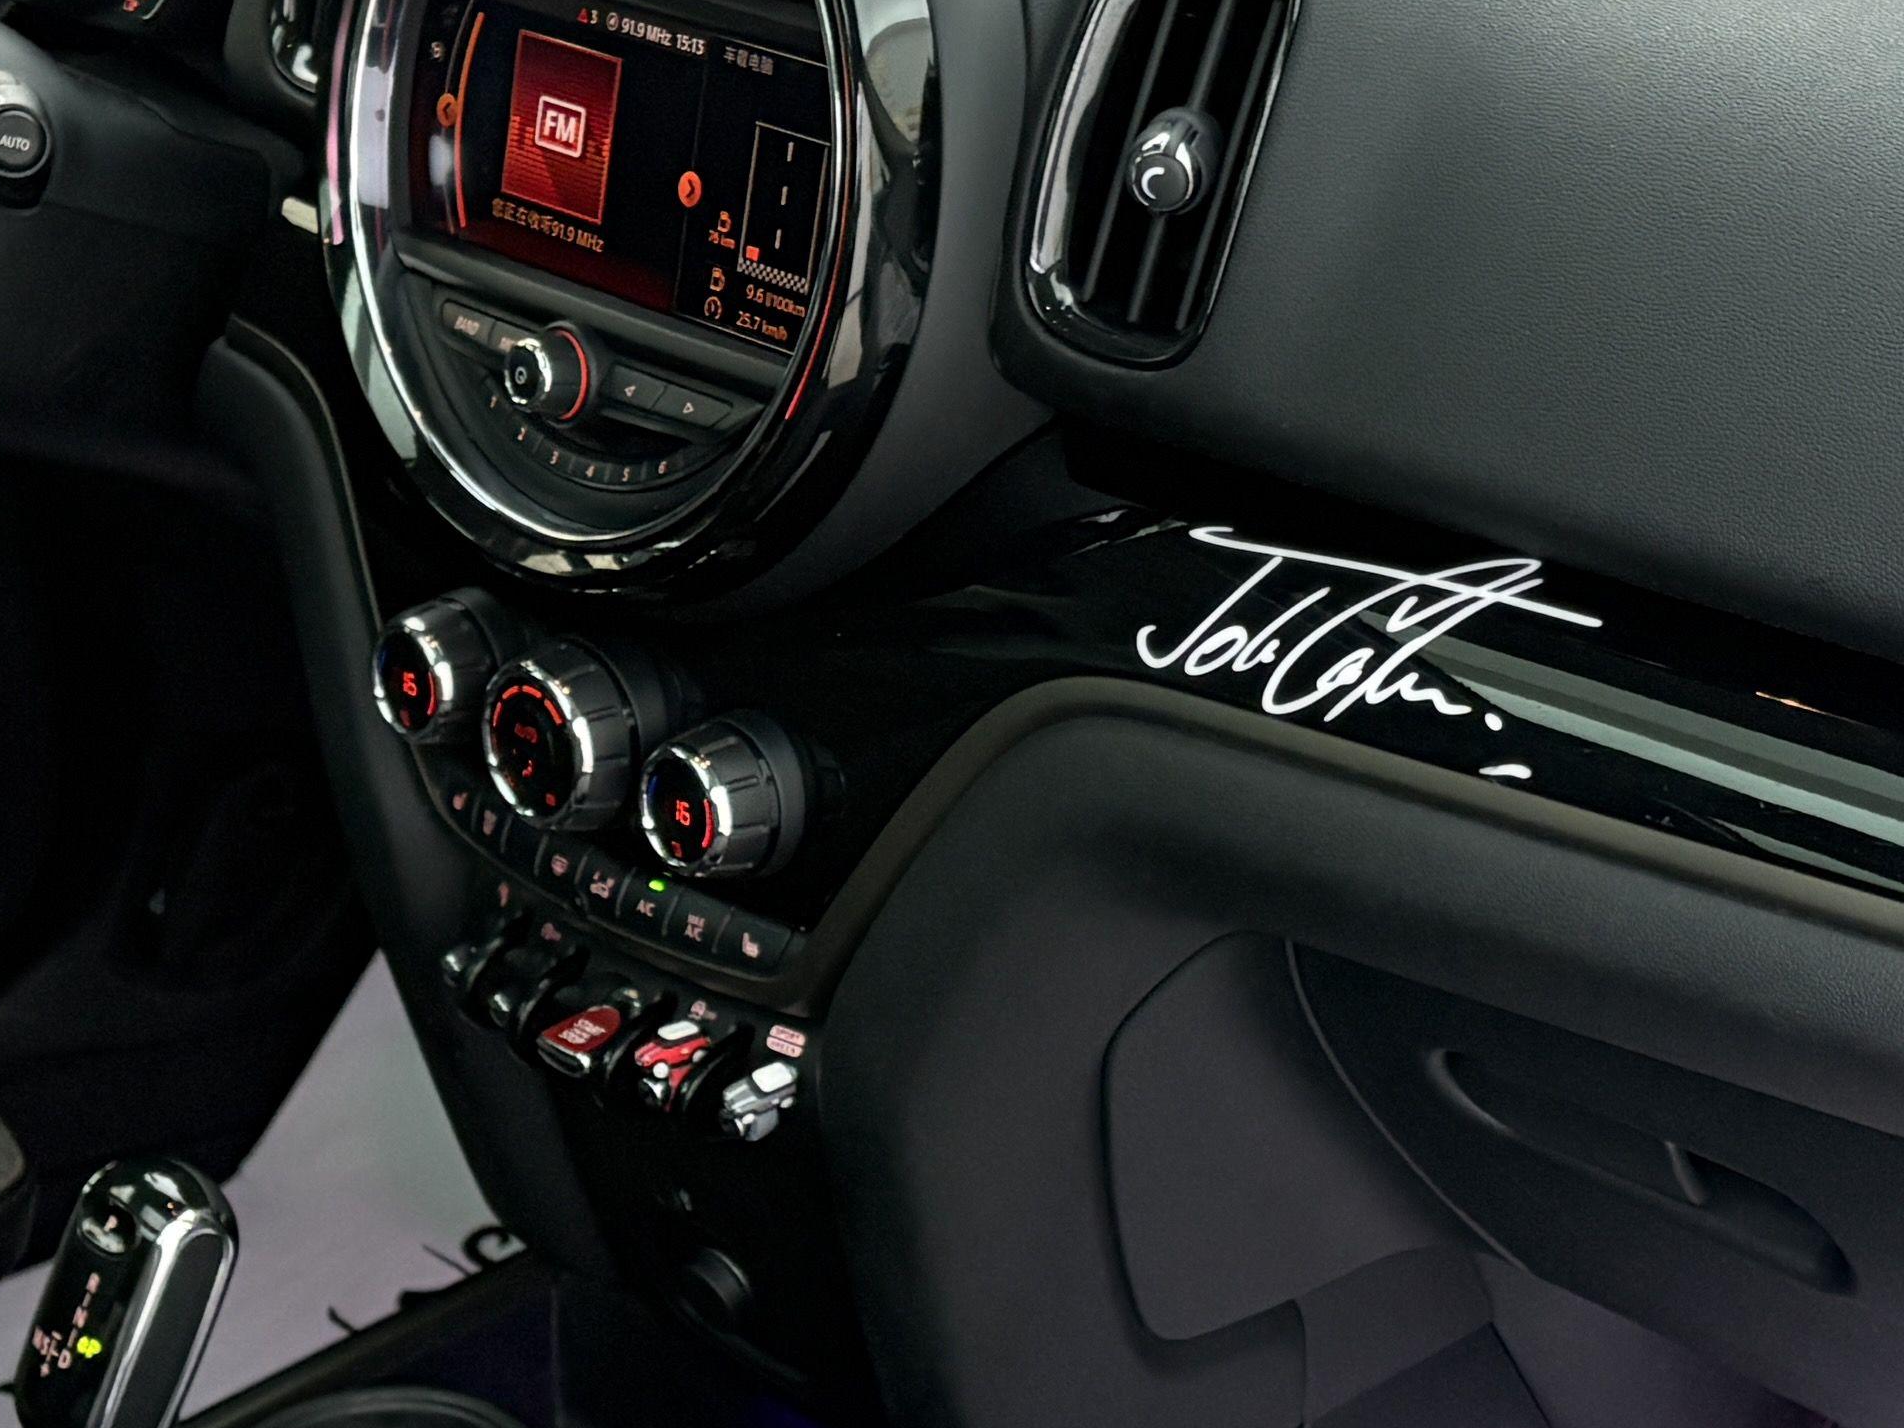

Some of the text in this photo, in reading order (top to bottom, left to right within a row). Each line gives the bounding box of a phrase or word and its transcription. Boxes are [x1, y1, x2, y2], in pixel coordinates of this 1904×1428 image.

[646, 24, 673, 46] MHz
[543, 109, 577, 144] FM
[576, 229, 605, 253] MHz
[746, 283, 765, 304] 9.6
[621, 466, 631, 482] 5
